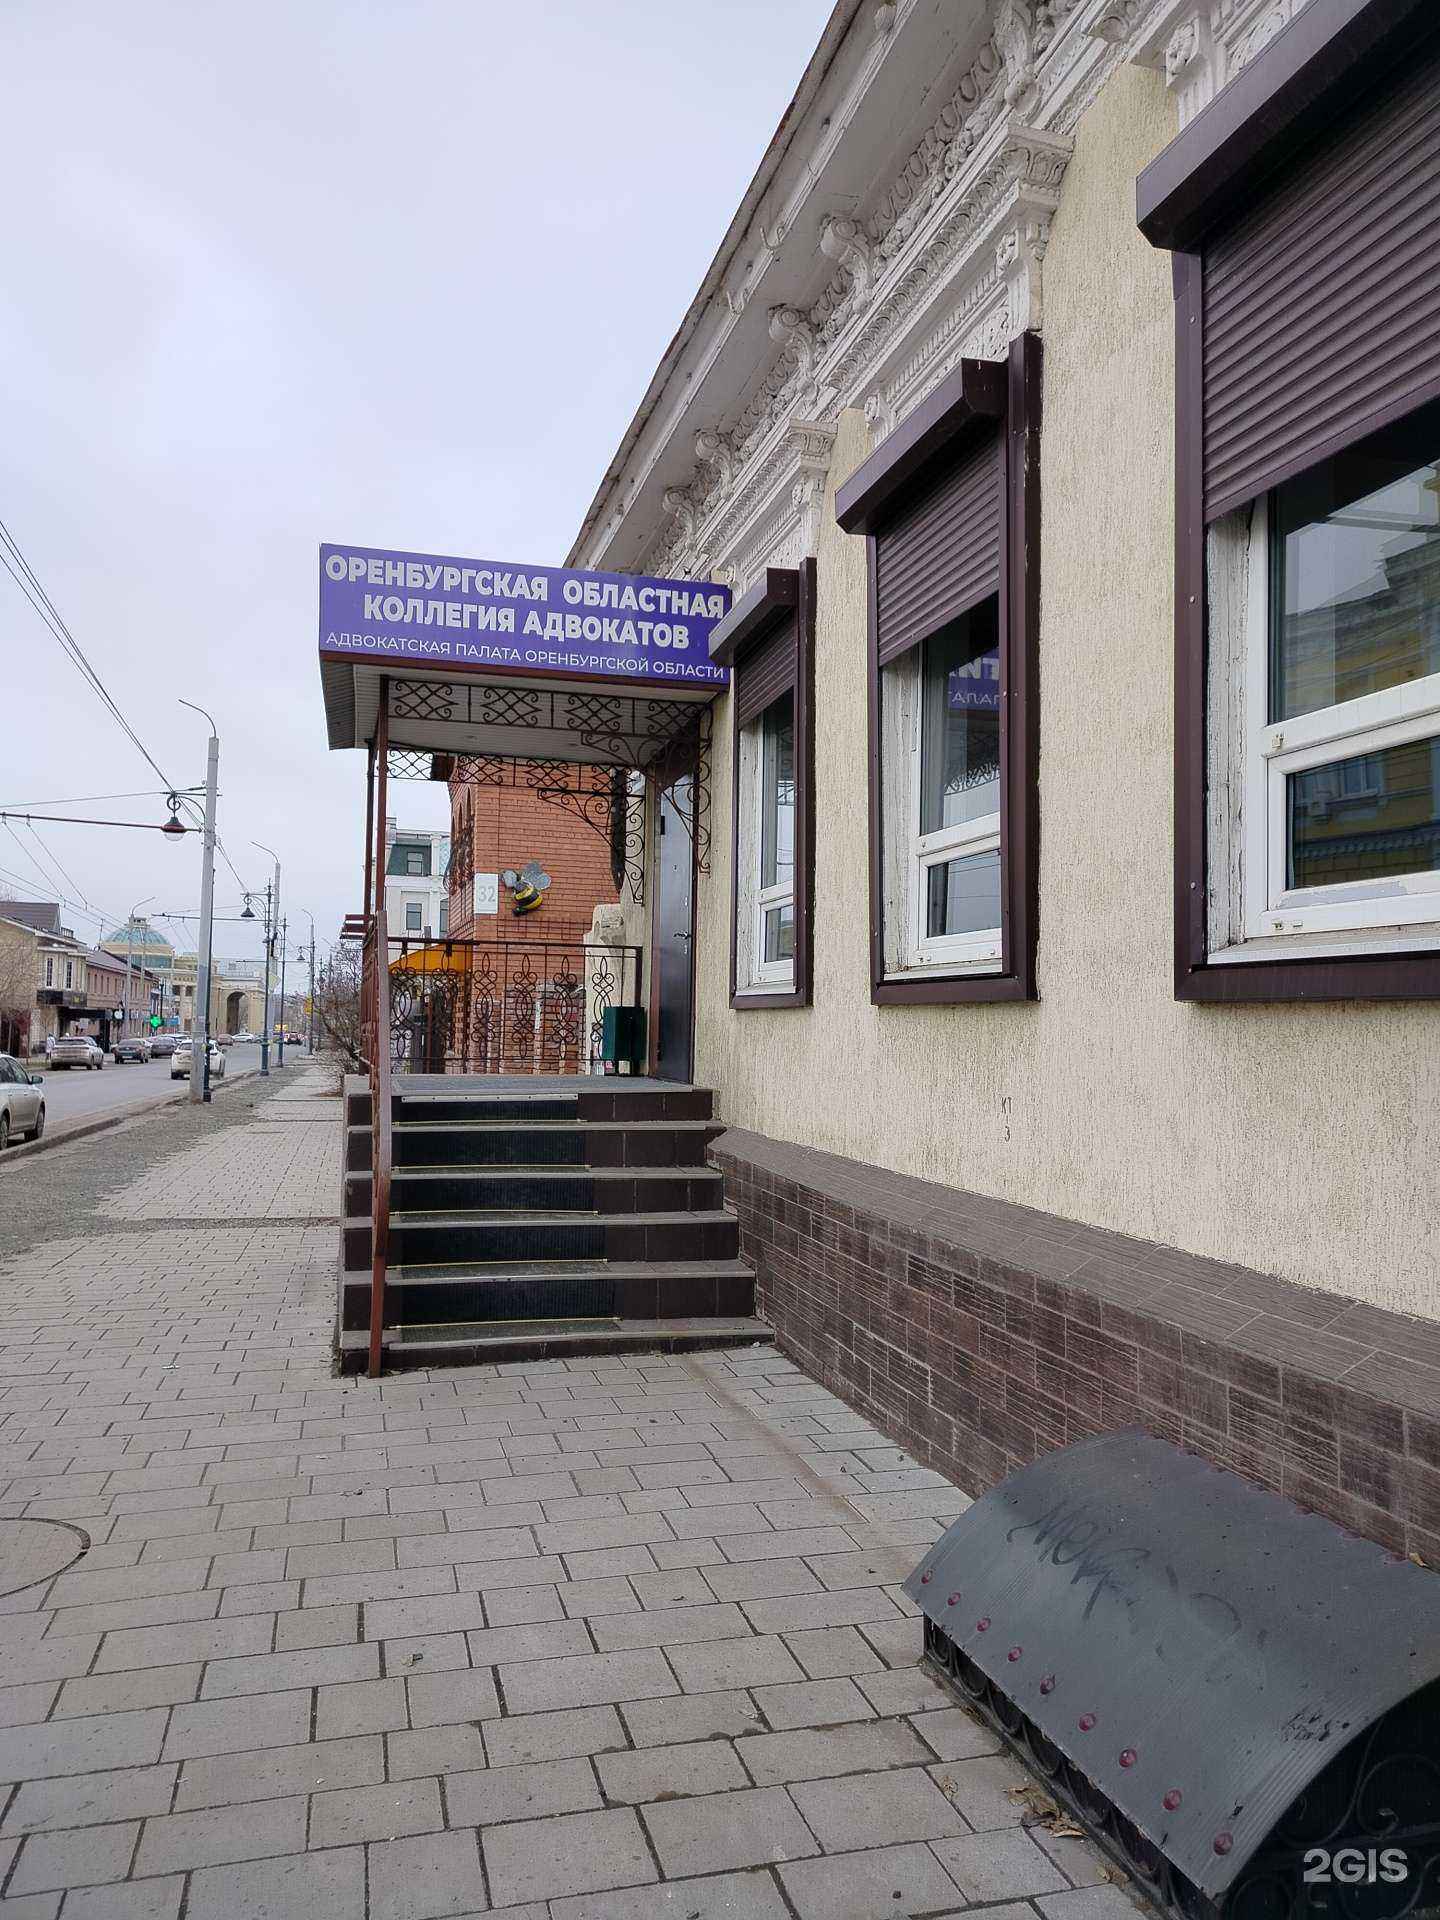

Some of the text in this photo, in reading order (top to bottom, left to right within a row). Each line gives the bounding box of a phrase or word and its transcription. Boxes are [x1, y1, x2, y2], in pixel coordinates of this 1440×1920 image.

[325, 554, 725, 619] ОРЕНБУРГСКАЯ ОБЛАСТНАЯ
[363, 594, 690, 650] КОЛЛЕГИЯ АДВОКАТОВ
[326, 632, 724, 680] АДВОКАТСКАЯ ПАЛАТА ОРЕНБУРГСКОЙ ОБЛАСТИ
[478, 886, 495, 903] 32
